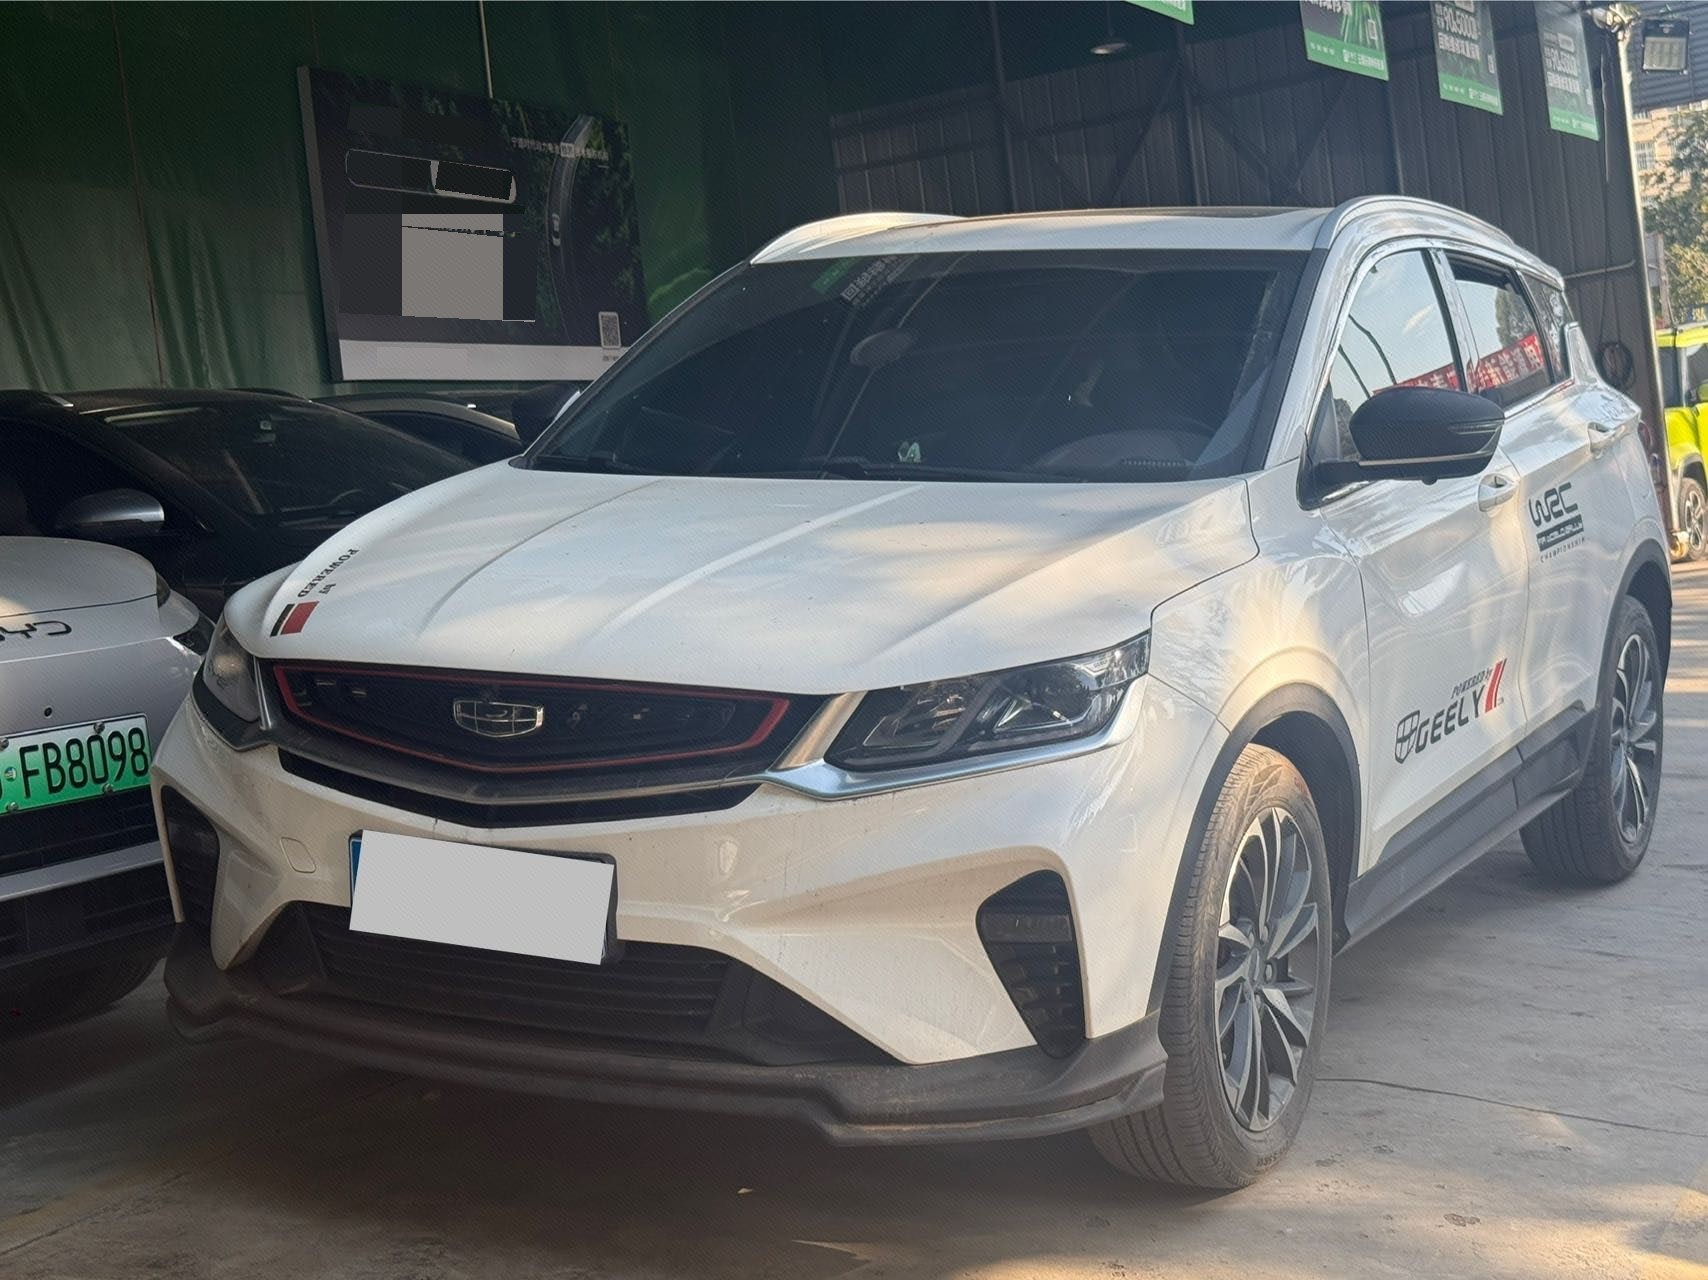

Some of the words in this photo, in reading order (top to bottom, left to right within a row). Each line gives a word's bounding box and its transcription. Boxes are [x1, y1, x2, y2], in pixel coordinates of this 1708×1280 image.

[297, 548, 360, 597] POWERED
[1414, 684, 1486, 754] GEELY
[19, 727, 149, 799] FB8098
